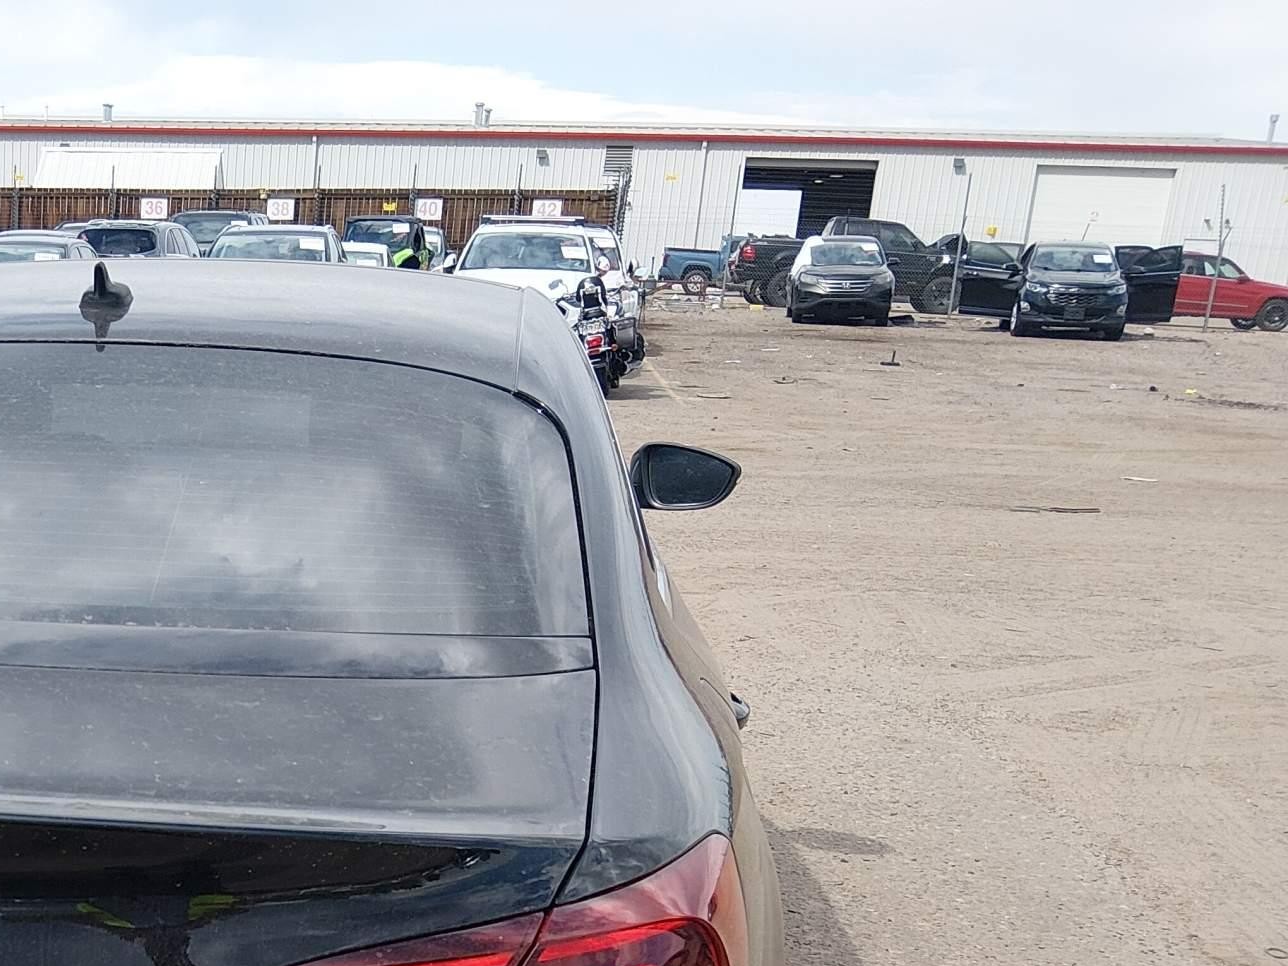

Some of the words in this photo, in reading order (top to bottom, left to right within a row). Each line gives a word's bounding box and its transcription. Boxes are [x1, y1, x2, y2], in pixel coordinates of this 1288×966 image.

[145, 200, 164, 216] 36
[271, 201, 290, 217] 38
[418, 201, 438, 217] 40
[537, 202, 557, 217] 42
